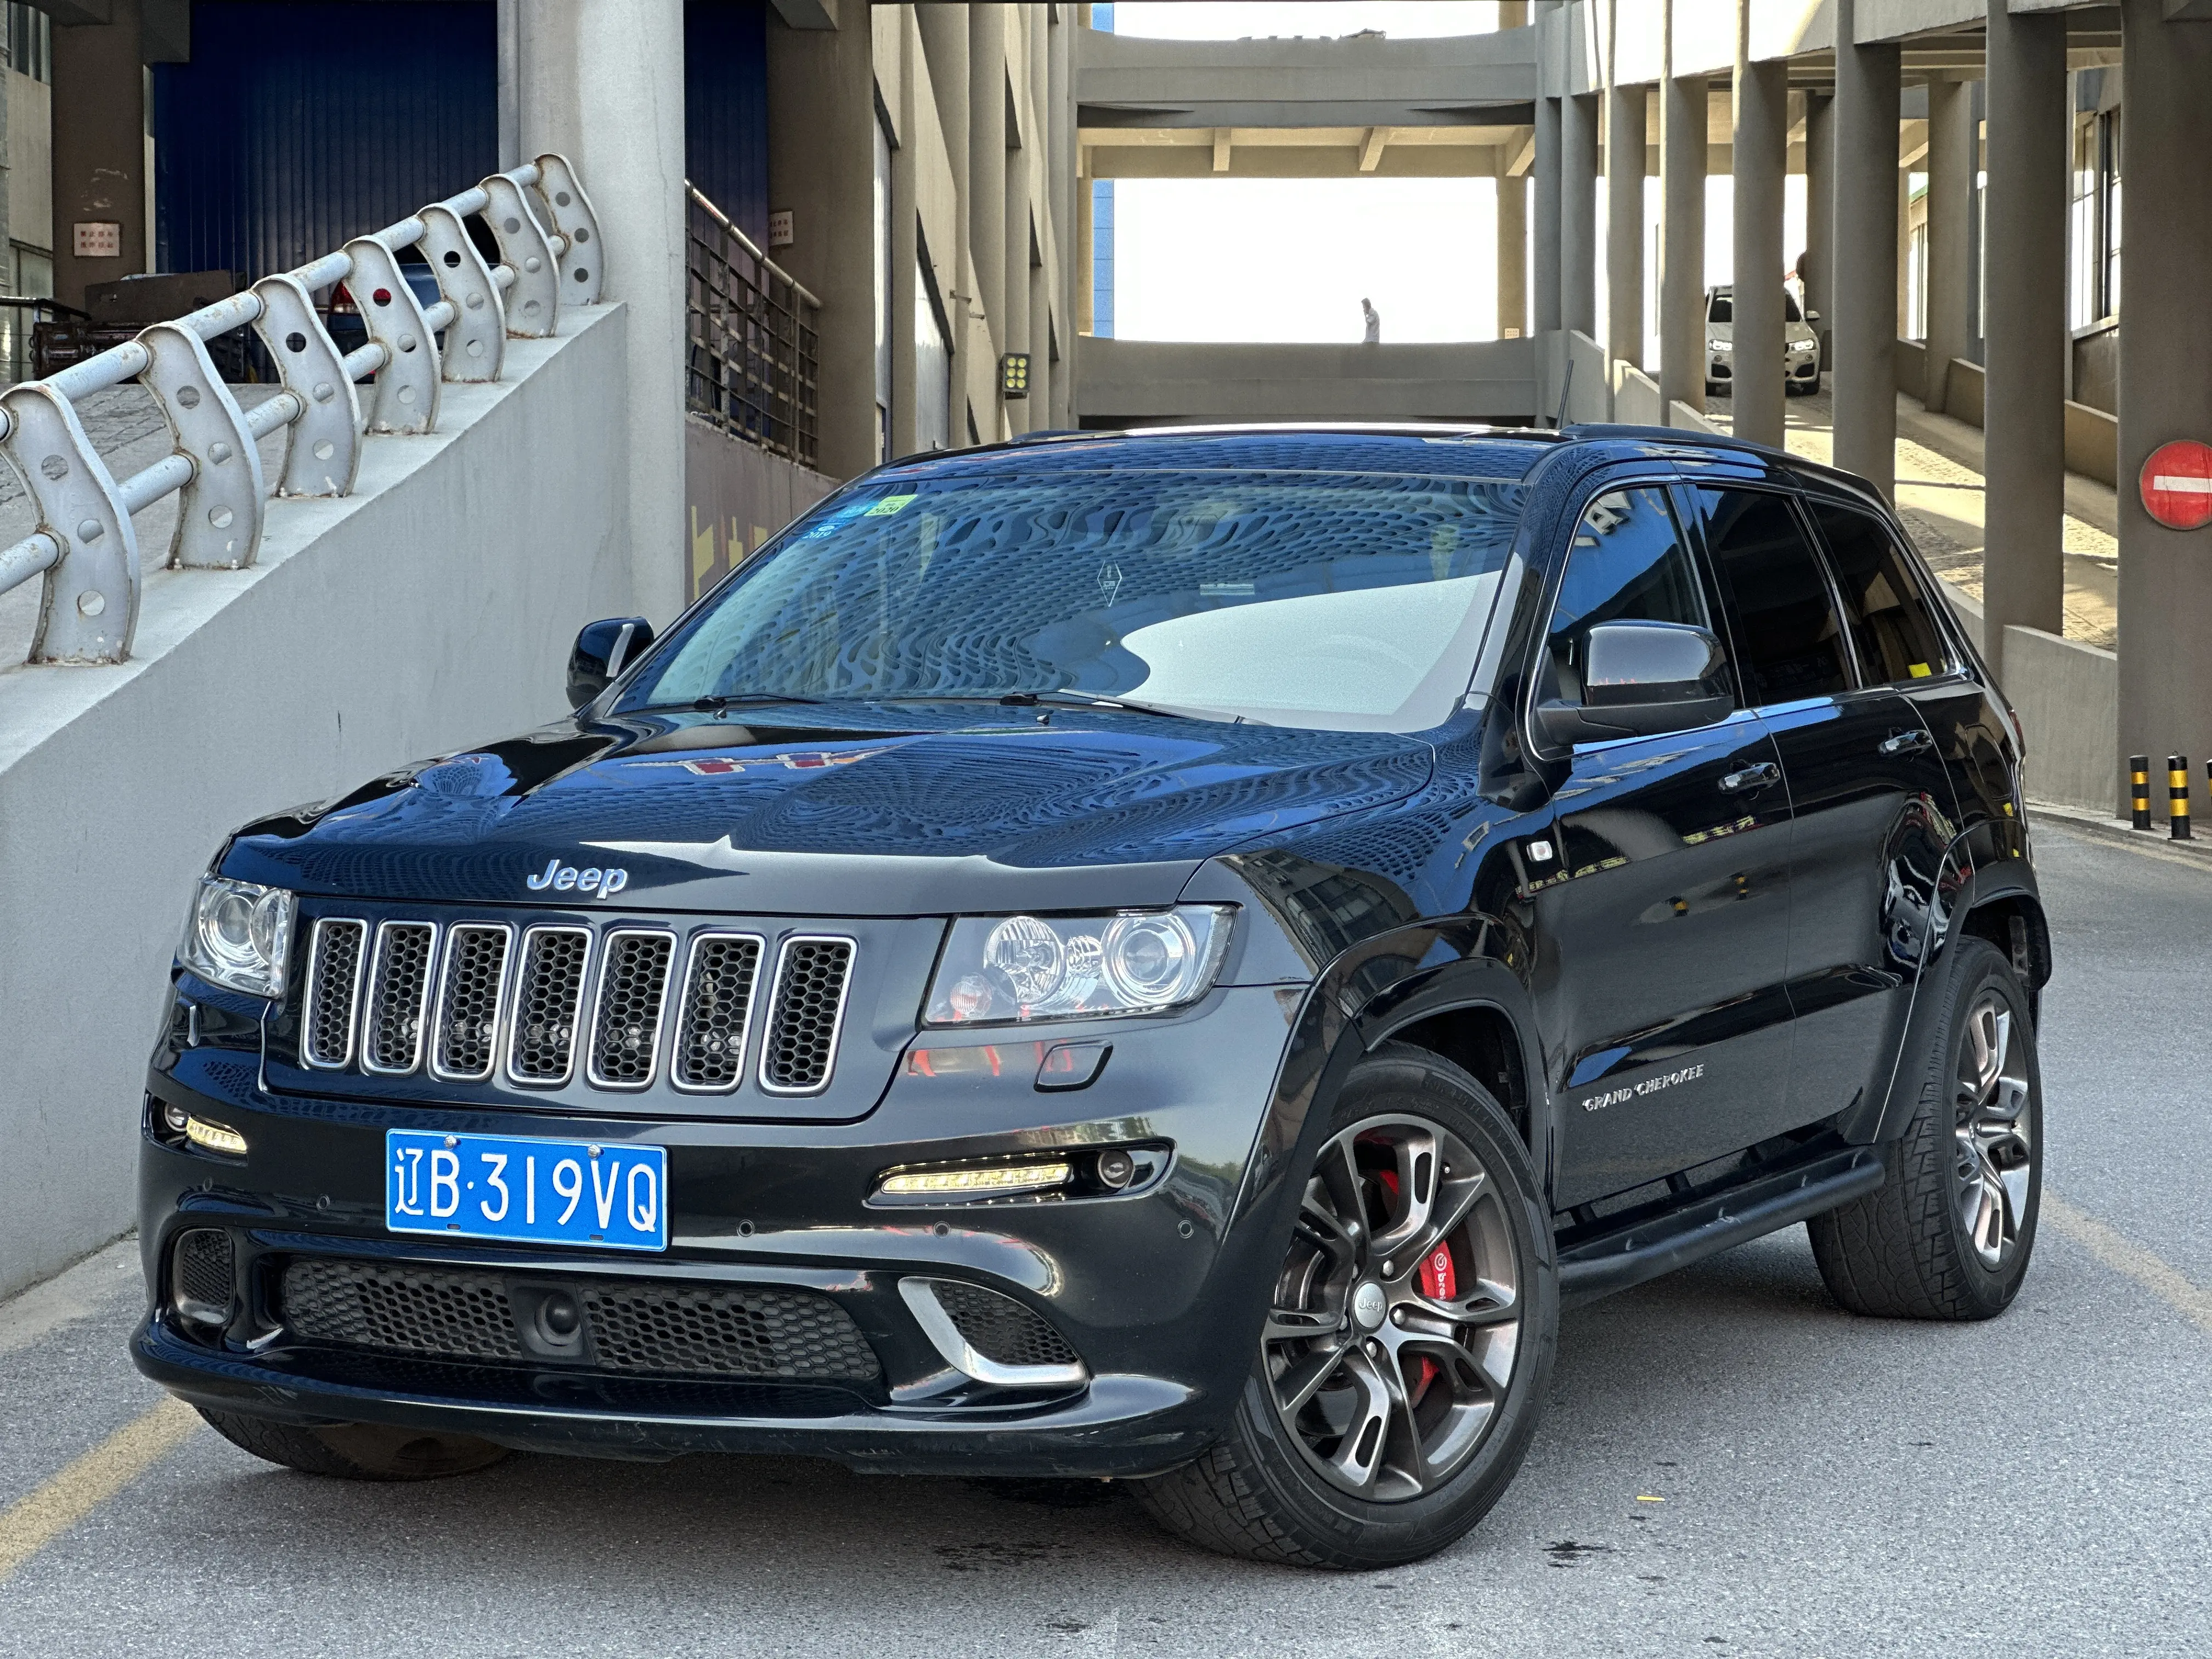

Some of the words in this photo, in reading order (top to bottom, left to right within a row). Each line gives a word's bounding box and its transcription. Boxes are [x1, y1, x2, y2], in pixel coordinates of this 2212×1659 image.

[870, 506, 900, 515] 2020
[527, 859, 628, 899] Jeep
[1582, 1088, 1633, 1111] GRAND
[1634, 1064, 1705, 1096] CHEROKEE
[394, 1148, 657, 1233] 辽B·319VQ
[1359, 1297, 1383, 1312] Jeep
